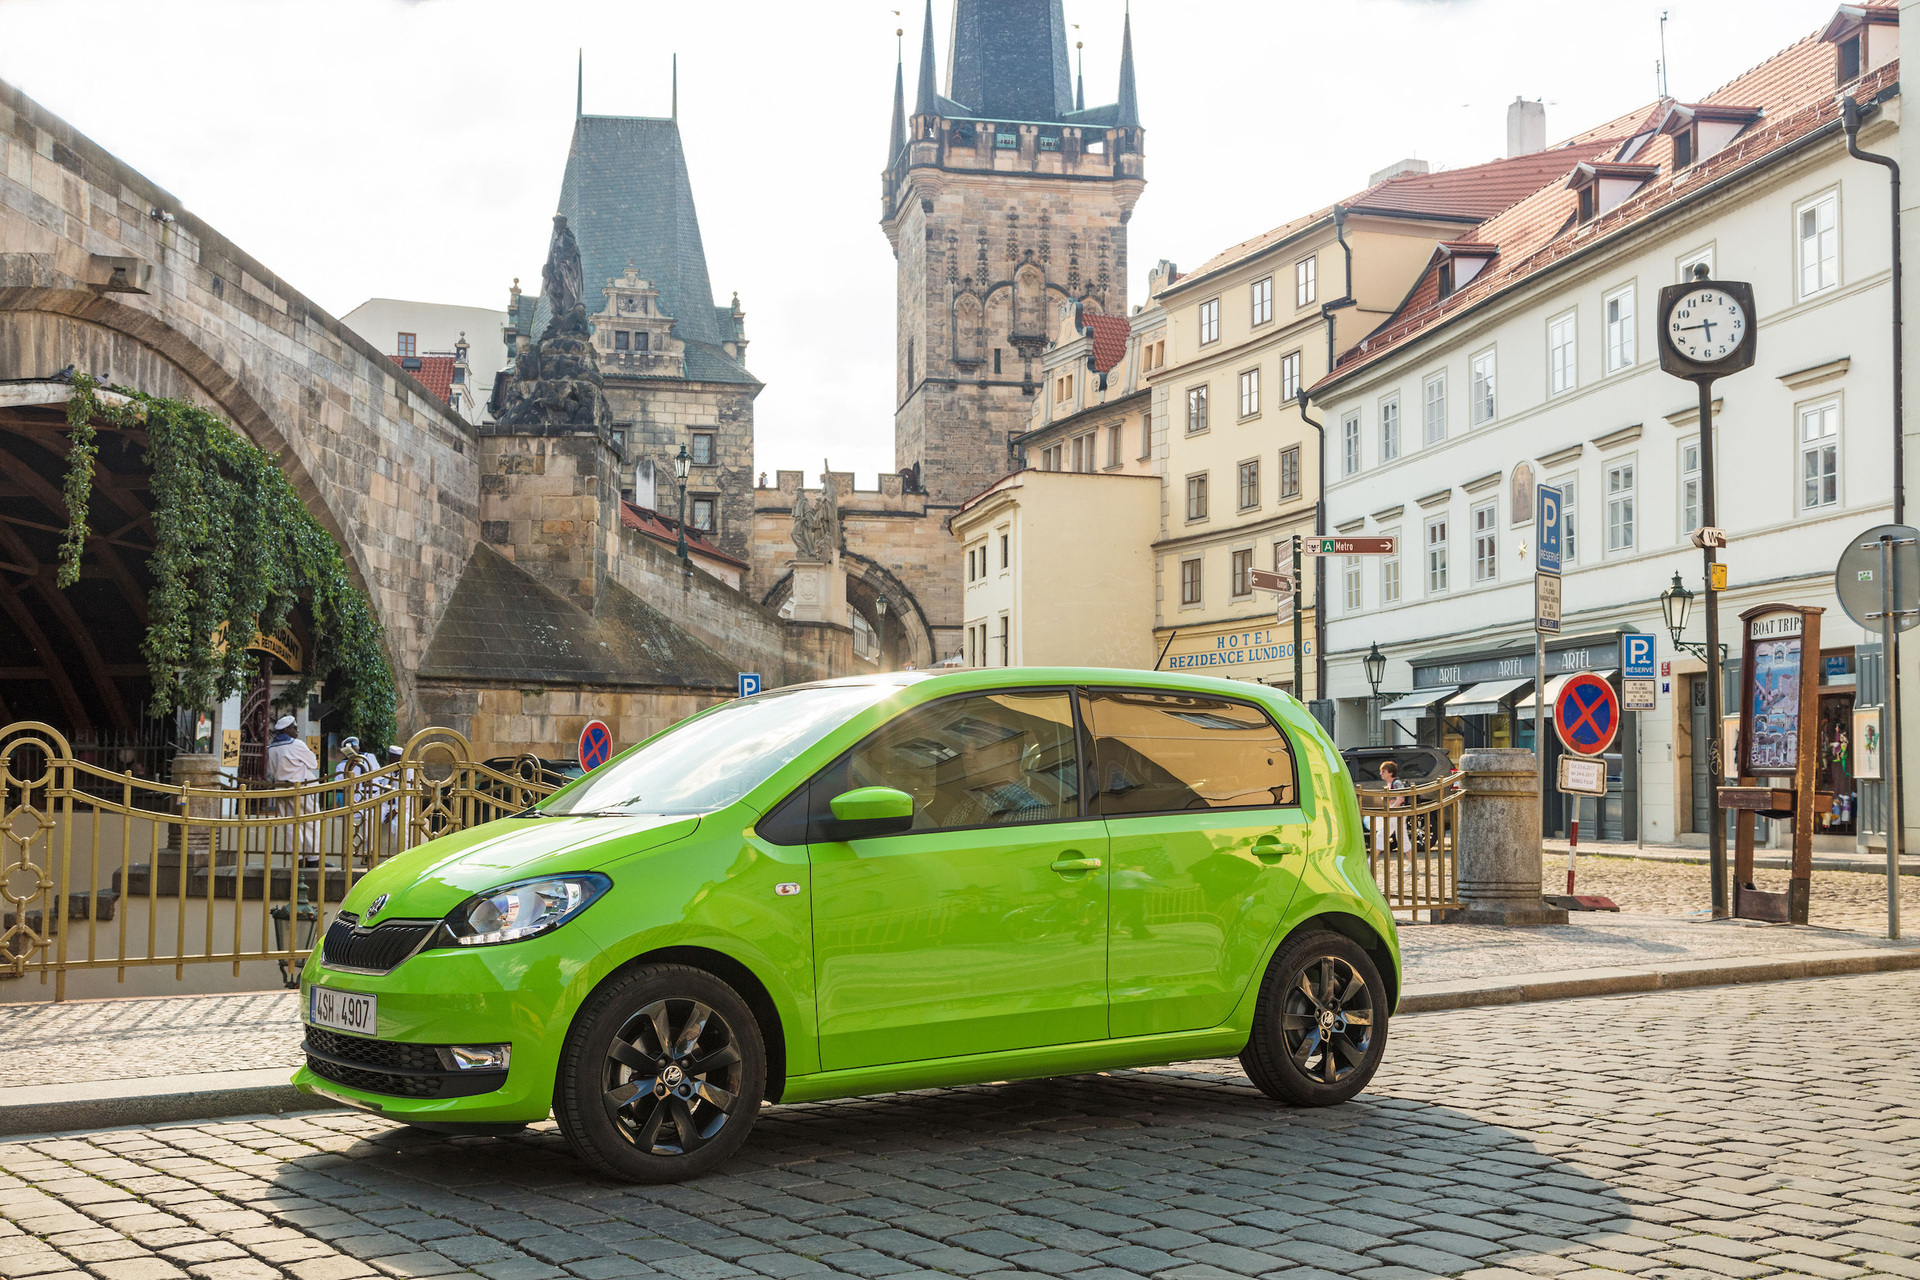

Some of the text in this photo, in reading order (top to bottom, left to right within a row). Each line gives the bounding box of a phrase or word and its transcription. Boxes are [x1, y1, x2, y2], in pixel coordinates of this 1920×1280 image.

[1701, 294, 1713, 303] 12
[1718, 297, 1723, 306] 1
[1687, 299, 1697, 308] 11
[1677, 310, 1690, 319] 10
[1728, 306, 1736, 315] 2
[1673, 323, 1680, 332] 9
[1734, 320, 1741, 329] 3
[1677, 337, 1686, 346] 8
[1728, 333, 1735, 342] 4
[1689, 346, 1696, 355] 7
[1704, 349, 1712, 358] 6
[1719, 345, 1726, 354] 5
[1543, 497, 1557, 544] P
[1324, 542, 1333, 551] A
[1336, 541, 1354, 551] Metro
[1753, 620, 1775, 636] BOAT
[1217, 631, 1273, 649] HOTEL
[1169, 641, 1312, 669] REZIDENCE LUNDBOG
[1630, 639, 1649, 665] P
[743, 678, 756, 697] P
[317, 992, 370, 1029] 4SH 4907
